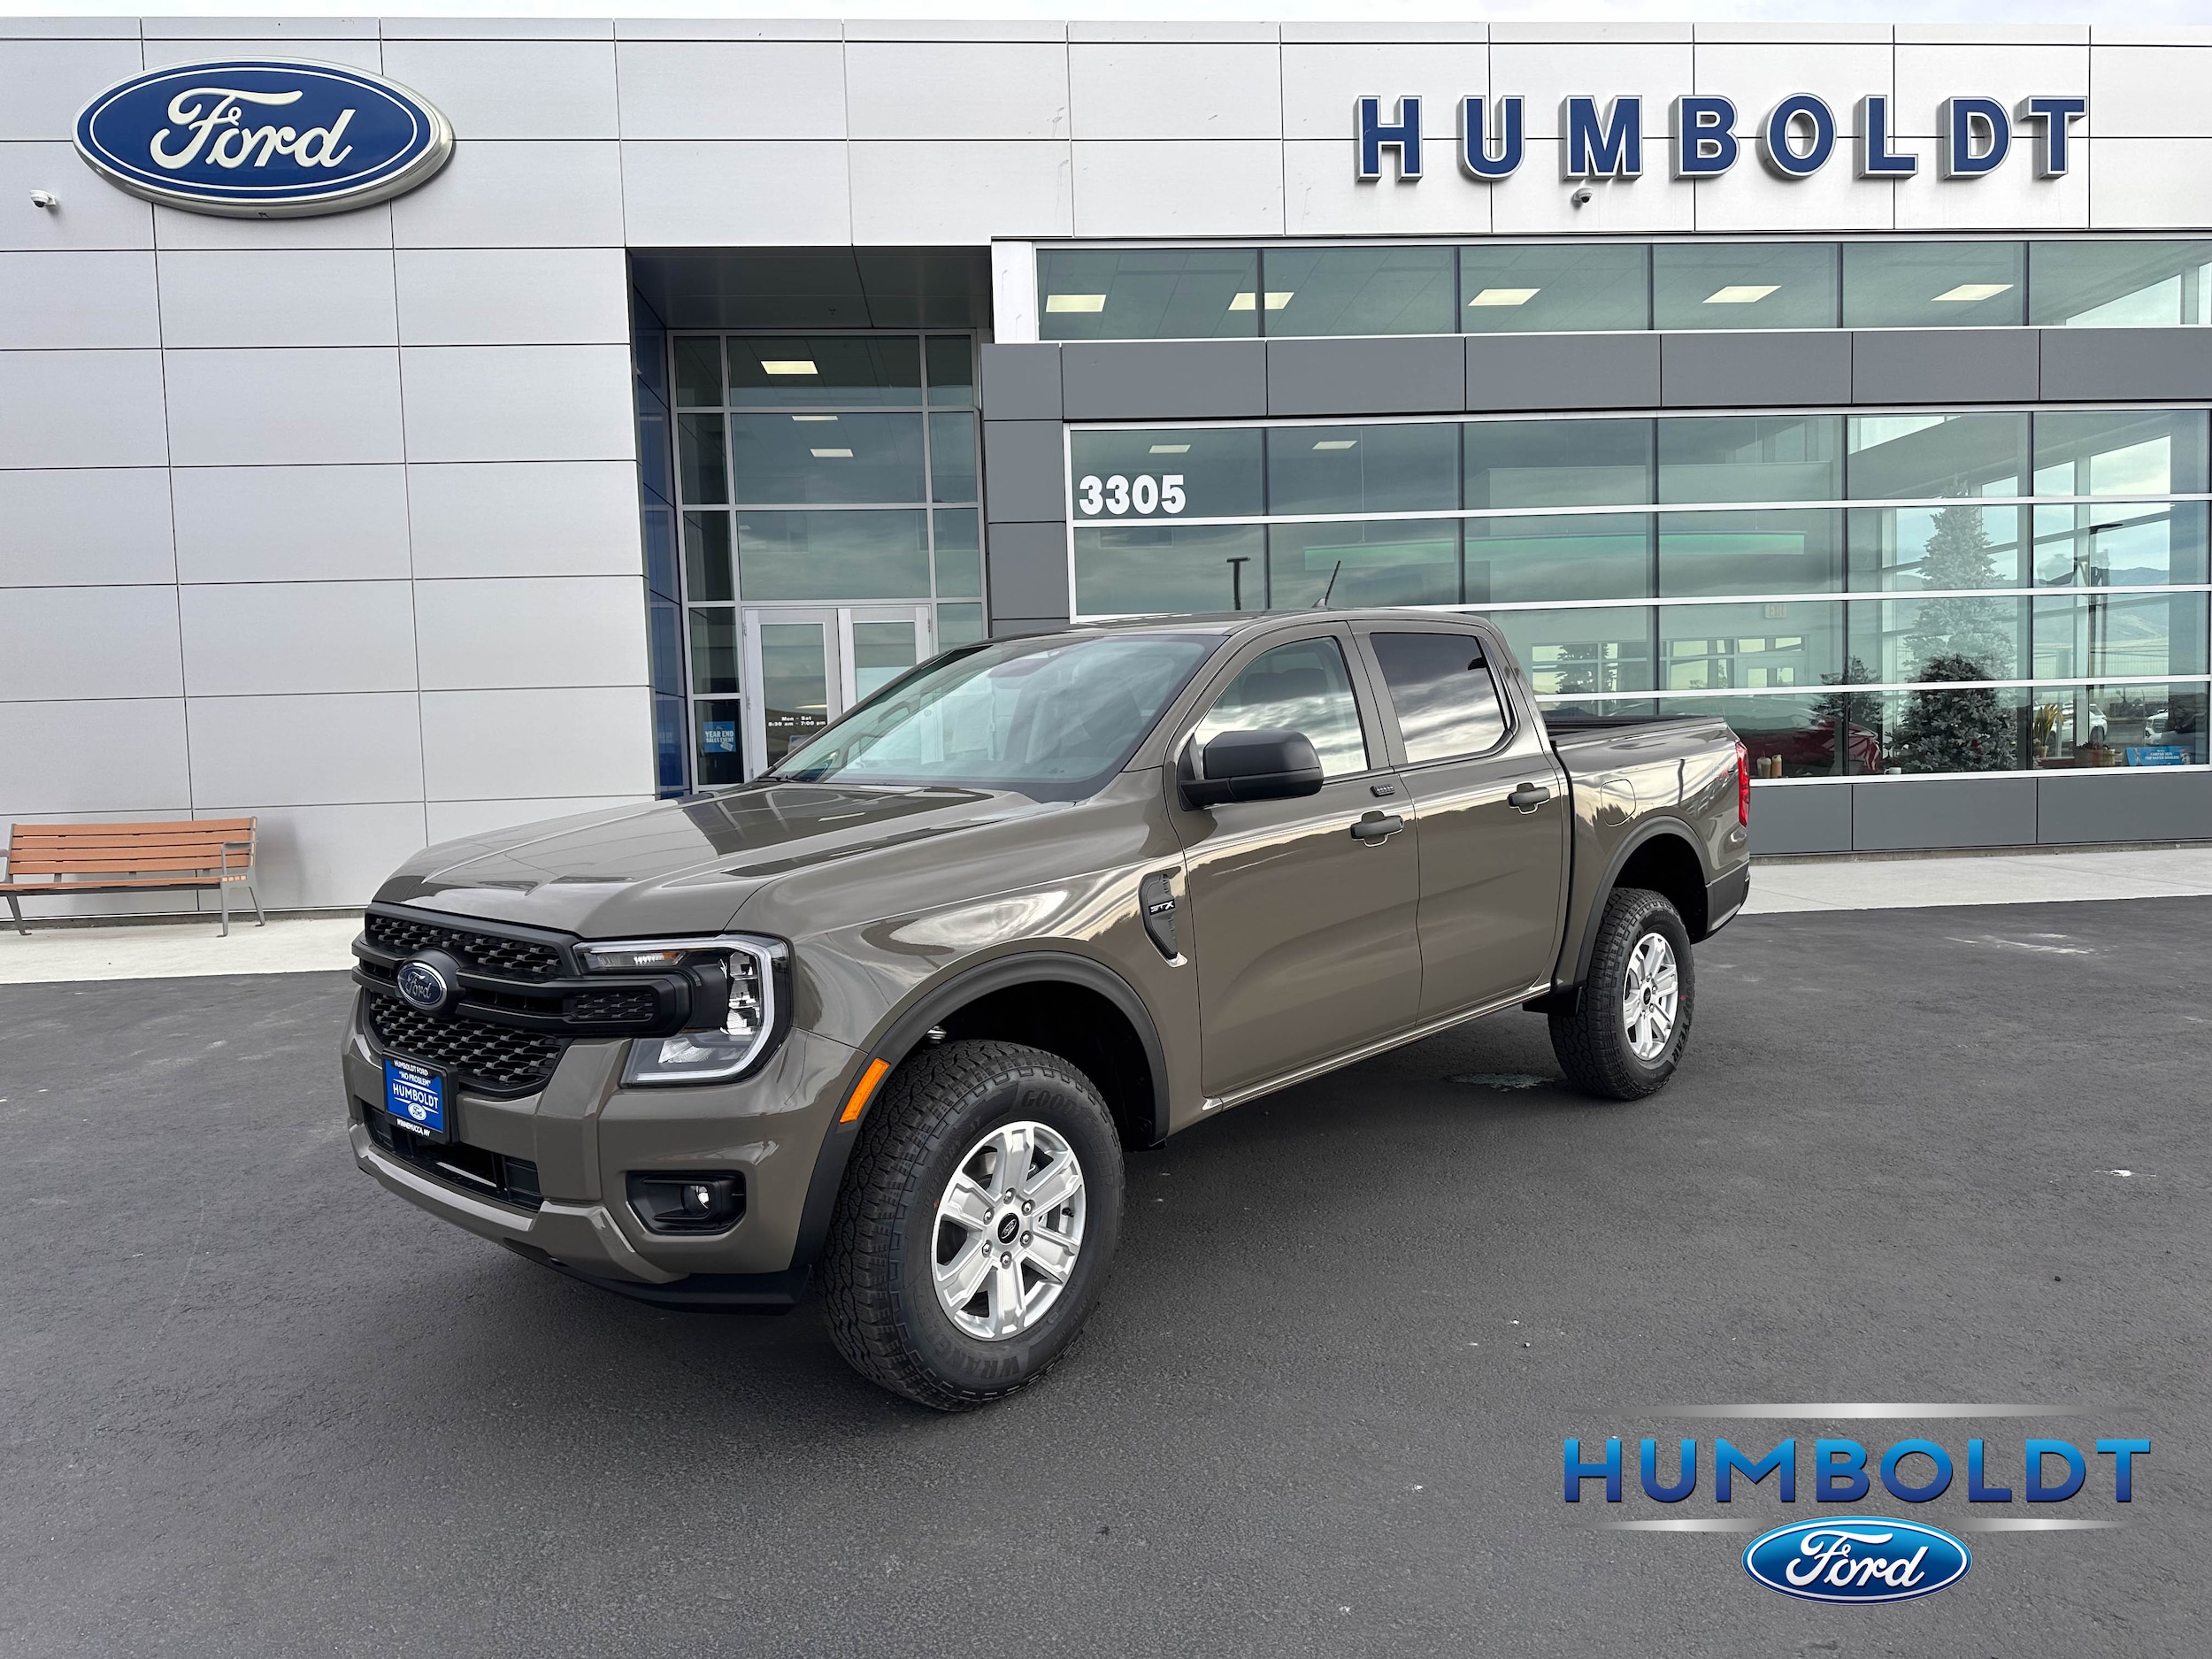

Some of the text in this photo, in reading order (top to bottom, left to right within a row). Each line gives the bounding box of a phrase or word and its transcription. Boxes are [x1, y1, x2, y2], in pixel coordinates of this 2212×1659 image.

[150, 87, 356, 170] Ford
[1354, 93, 2088, 181] HUMBOLDT
[1079, 474, 1187, 515] 3305
[1150, 901, 1174, 913] STX
[405, 971, 432, 999] Ford
[394, 1059, 428, 1077] HUMBOLDT FORD
[392, 1082, 439, 1110] HUMBOLDT
